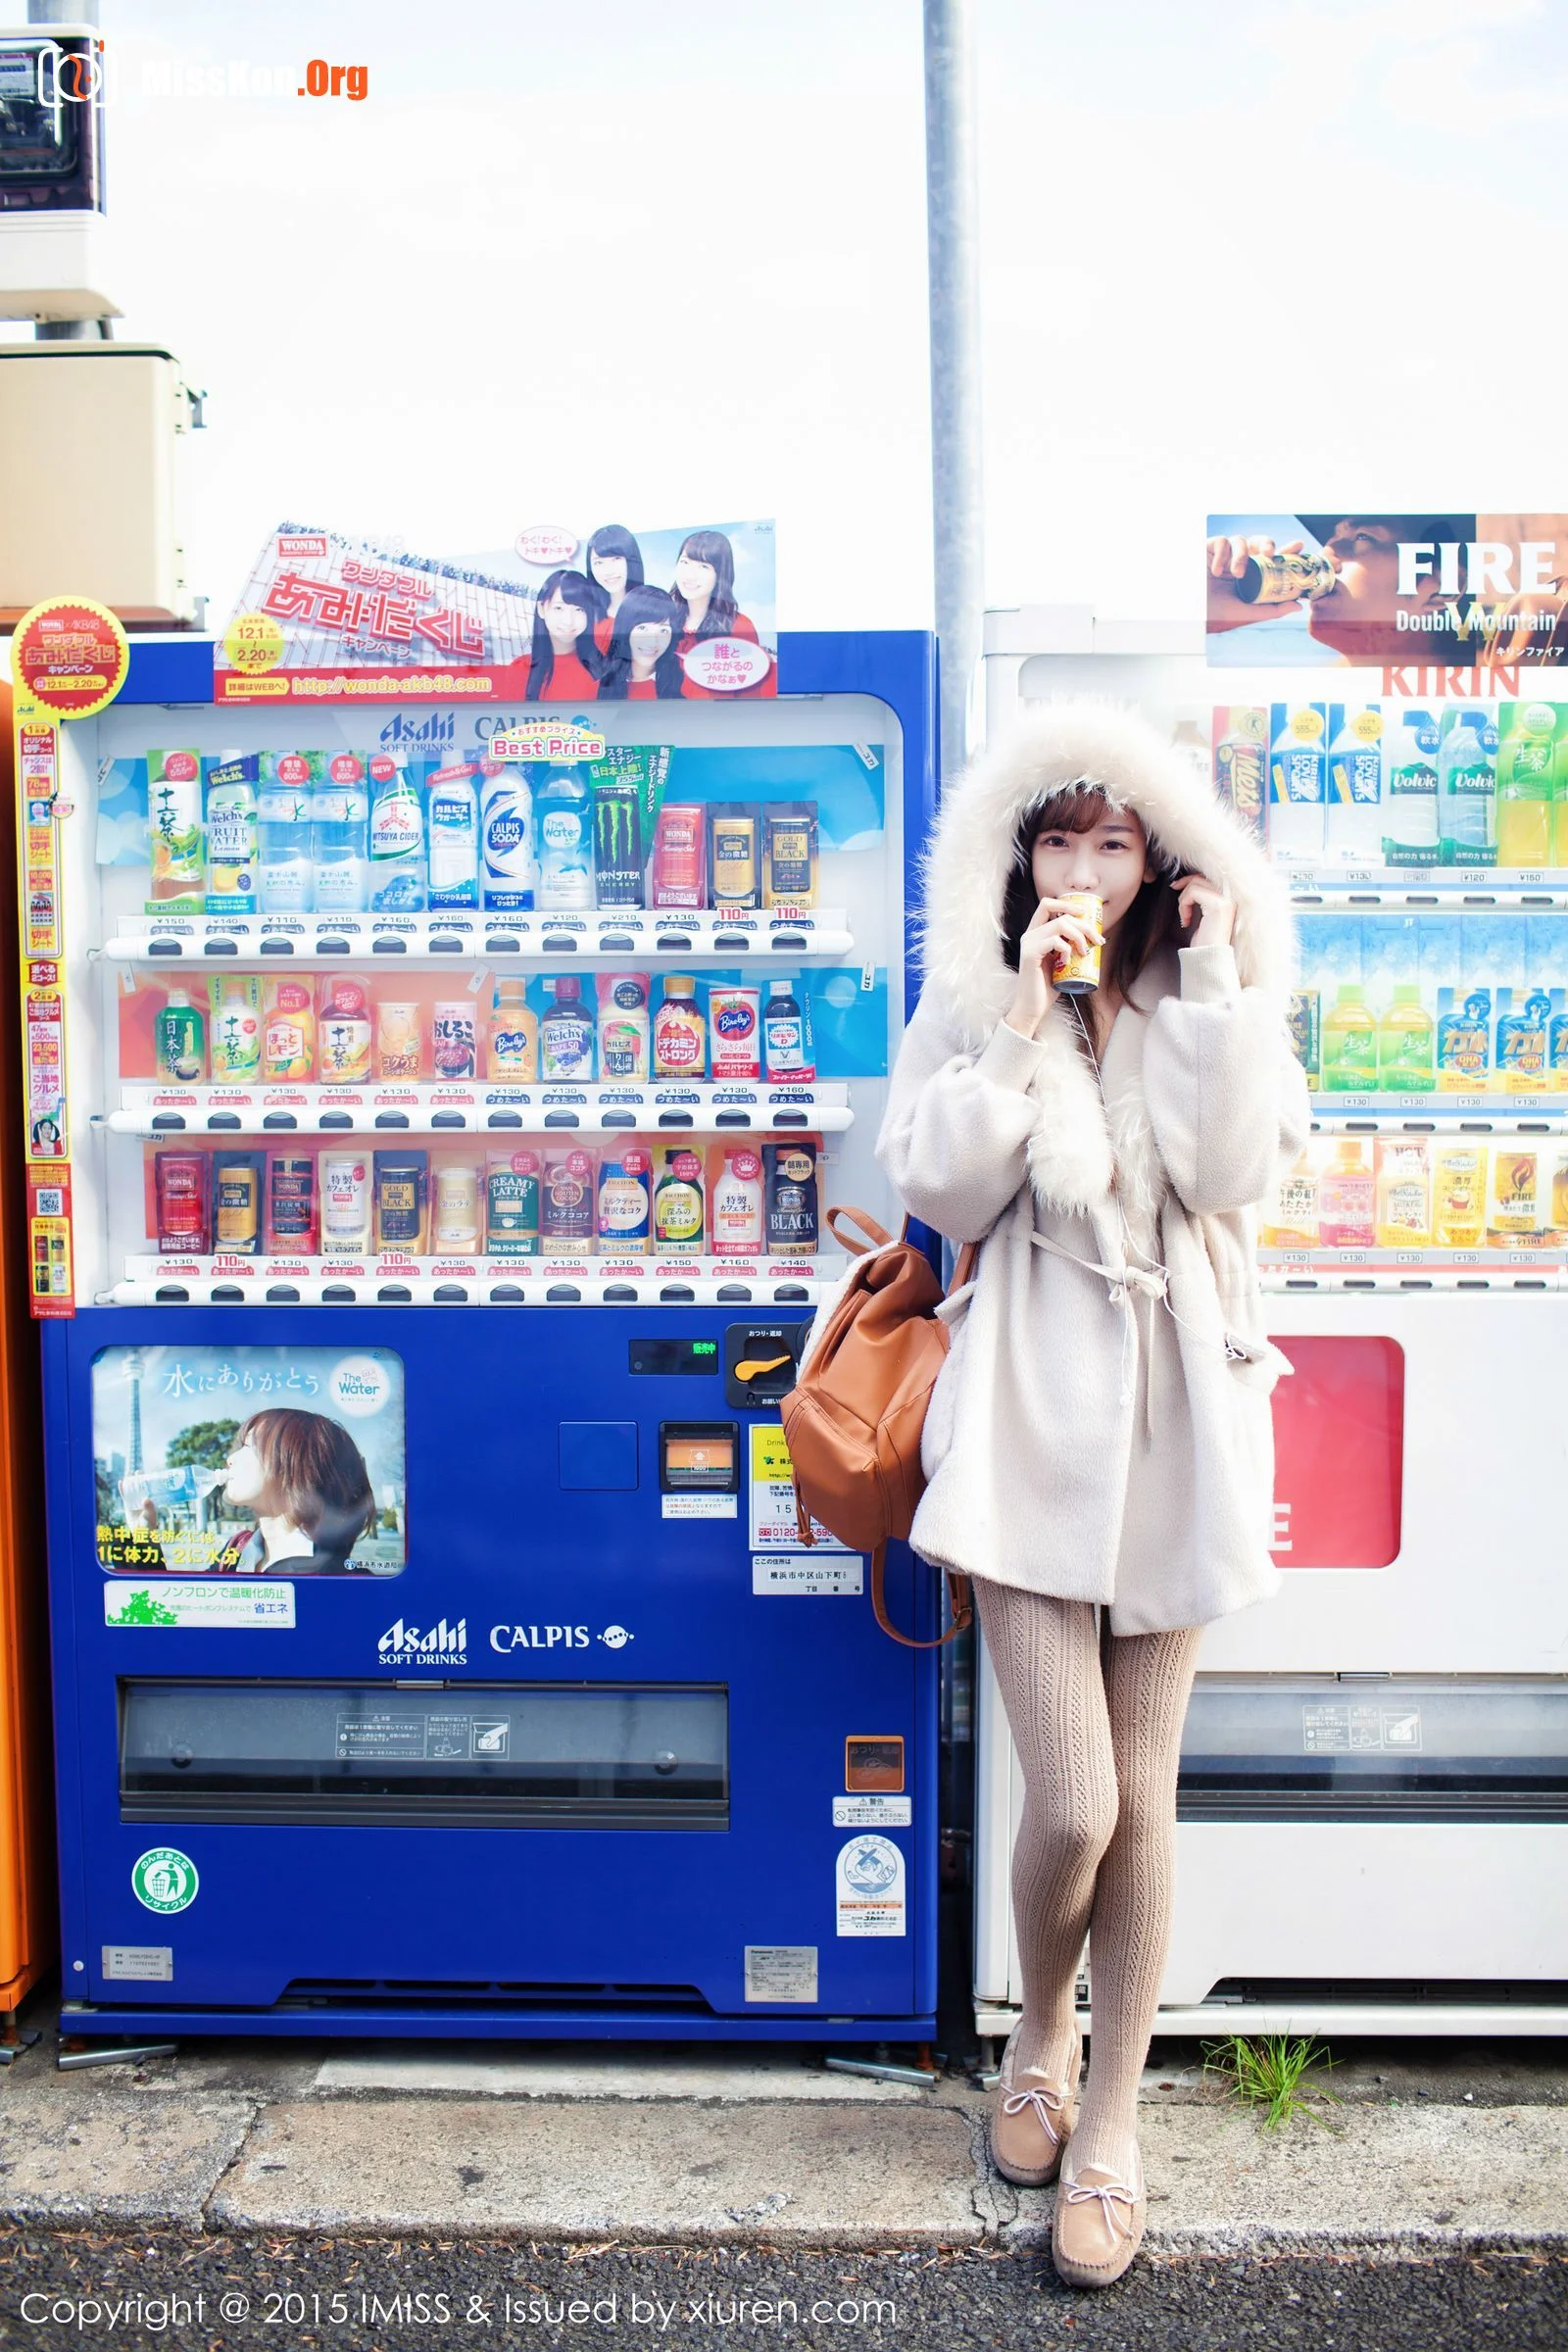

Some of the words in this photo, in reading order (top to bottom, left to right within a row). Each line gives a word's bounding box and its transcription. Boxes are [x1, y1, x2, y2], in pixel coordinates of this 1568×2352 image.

[281, 540, 325, 551] WONDA
[1396, 542, 1557, 595] FIRE
[341, 560, 433, 602] ワンダフル
[261, 571, 486, 660] あみだくじ
[1396, 610, 1460, 632] Double
[1467, 610, 1557, 632] Mountain
[71, 618, 101, 631] AKB48
[237, 627, 265, 639] 12.1
[342, 635, 412, 659] キャンペーン
[713, 643, 741, 660] 誰と
[1495, 645, 1565, 658] キリンファイア
[25, 645, 116, 665] あみだくじ
[237, 649, 267, 662] 2.20
[48, 664, 94, 674] キャンペーン
[701, 662, 754, 672] つながるの
[293, 676, 492, 695] http://wonda-akb48.com
[1381, 666, 1519, 697] KIRIN
[379, 712, 455, 742] Asahi
[380, 743, 410, 753] SOFT
[411, 743, 455, 753] DRINKS
[493, 739, 543, 756] Best
[549, 739, 601, 755] Price
[609, 754, 642, 765] エナジー
[1514, 744, 1545, 772] 生茶
[371, 764, 392, 774] NEW
[647, 755, 658, 813] エナジードリンク
[1394, 772, 1437, 788] Volvic
[157, 787, 184, 843] 十六茶
[435, 805, 468, 813] カルピス
[211, 810, 243, 824] Welch's
[435, 812, 468, 821] ウォーター
[491, 822, 520, 834] CALPIS
[665, 829, 692, 839] WONDA
[399, 832, 419, 841] CIDER
[491, 833, 520, 844] SODA
[775, 850, 806, 858] BLACK
[718, 907, 750, 920] 110円
[775, 906, 808, 919] 110円
[280, 998, 300, 1008] No.1
[222, 1015, 245, 1065] 十六茶
[269, 1032, 298, 1045] ほっと
[546, 1029, 581, 1043] Welch's
[166, 1020, 182, 1075] 日本茶
[269, 1045, 300, 1056] レモン
[330, 1026, 349, 1071] 十六茶
[567, 1041, 579, 1051] 50
[1344, 1035, 1370, 1055] 生茶
[1402, 1035, 1428, 1055] 生茶
[381, 1055, 418, 1068] コクうま
[659, 1050, 696, 1061] ストロング
[787, 1160, 809, 1169] 朝専用
[331, 1174, 353, 1185] 特製
[489, 1177, 535, 1190] CREAMY
[326, 1184, 359, 1193] カフェオレ
[492, 1187, 528, 1198] LATTE
[604, 1198, 642, 1206] ミルクティー
[725, 1196, 747, 1205] 特製
[1512, 1192, 1533, 1200] FIRE
[382, 1199, 412, 1207] BLACK
[547, 1210, 590, 1220] ミルクココア
[604, 1206, 642, 1215] 贅沢なコク
[666, 1207, 691, 1216] 深みの
[770, 1212, 814, 1230] BLACK
[215, 1254, 246, 1267] 110円
[380, 1253, 412, 1264] 110円
[692, 1344, 716, 1354] 販売中
[162, 1363, 320, 1398] 水にありがとう
[343, 1372, 362, 1383] The
[338, 1381, 381, 1396] Water
[97, 1545, 247, 1564] 1に体力、2に水分。
[356, 1559, 398, 1569] 横浜市水道局
[770, 1571, 842, 1581] 横浜市中区山下町
[162, 1587, 286, 1599] ノンフロンで温暖化防止
[254, 1602, 289, 1614] 省エネ
[377, 1617, 467, 1653] Asahi
[489, 1625, 590, 1653] CALPIS
[378, 1653, 414, 1665] SOFT
[416, 1653, 467, 1665] DRINKS
[140, 1851, 190, 1871] のんだあとは
[144, 1895, 188, 1910] リサイクル
